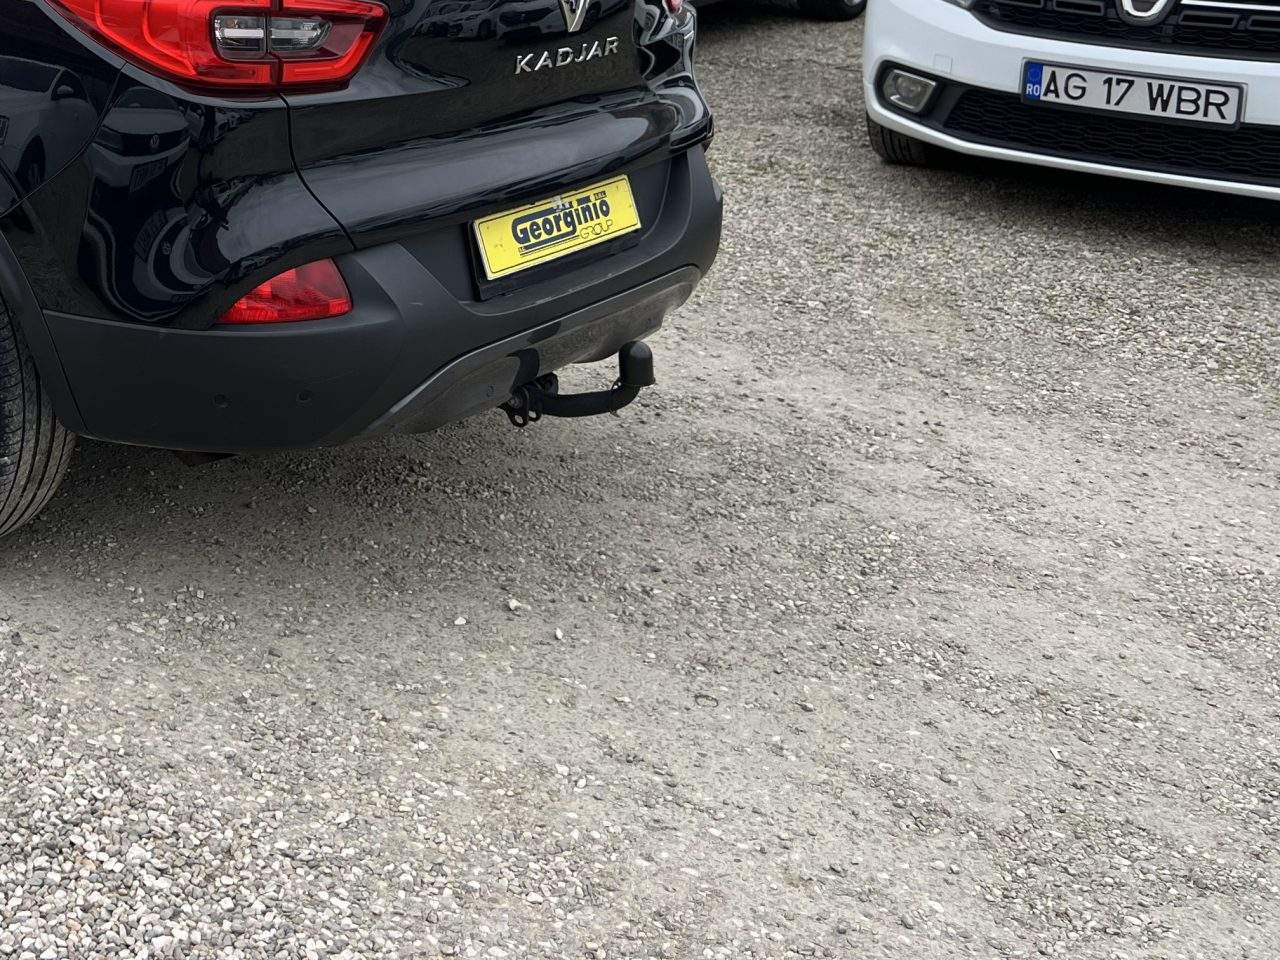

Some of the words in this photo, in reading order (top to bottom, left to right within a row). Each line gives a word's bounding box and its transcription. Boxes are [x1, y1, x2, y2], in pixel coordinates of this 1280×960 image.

[515, 36, 619, 75] KADJAR
[1026, 83, 1041, 97] RO
[1043, 70, 1088, 100] AG
[1103, 76, 1135, 106] 17
[1147, 81, 1231, 120] WBR
[511, 199, 610, 245] Georginio
[579, 219, 614, 240] GROUP
